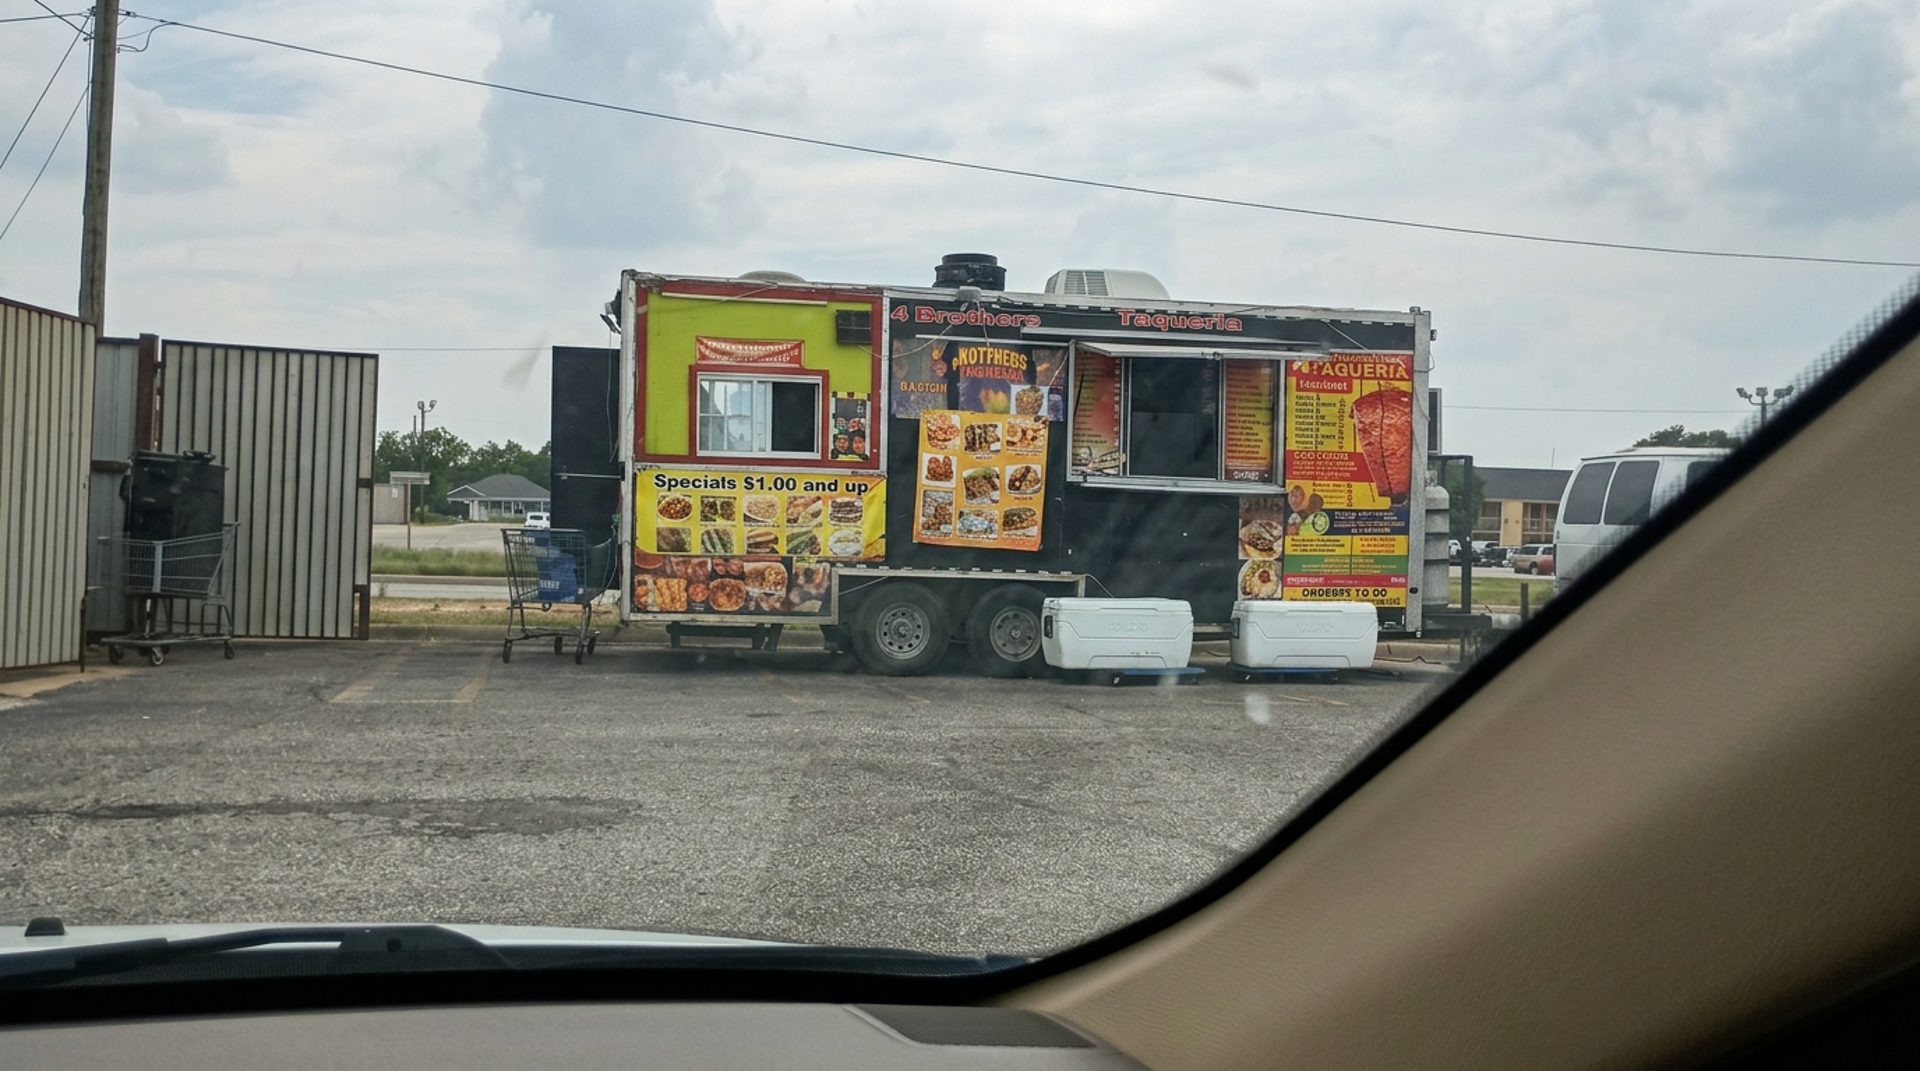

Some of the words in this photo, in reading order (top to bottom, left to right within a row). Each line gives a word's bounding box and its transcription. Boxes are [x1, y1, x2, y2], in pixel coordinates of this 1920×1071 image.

[890, 305, 909, 322] 4
[1118, 308, 1242, 331] Taqueria
[743, 476, 797, 492] $1.00
[803, 479, 838, 493] and
[845, 481, 870, 496] up
[1355, 588, 1370, 598] TO
